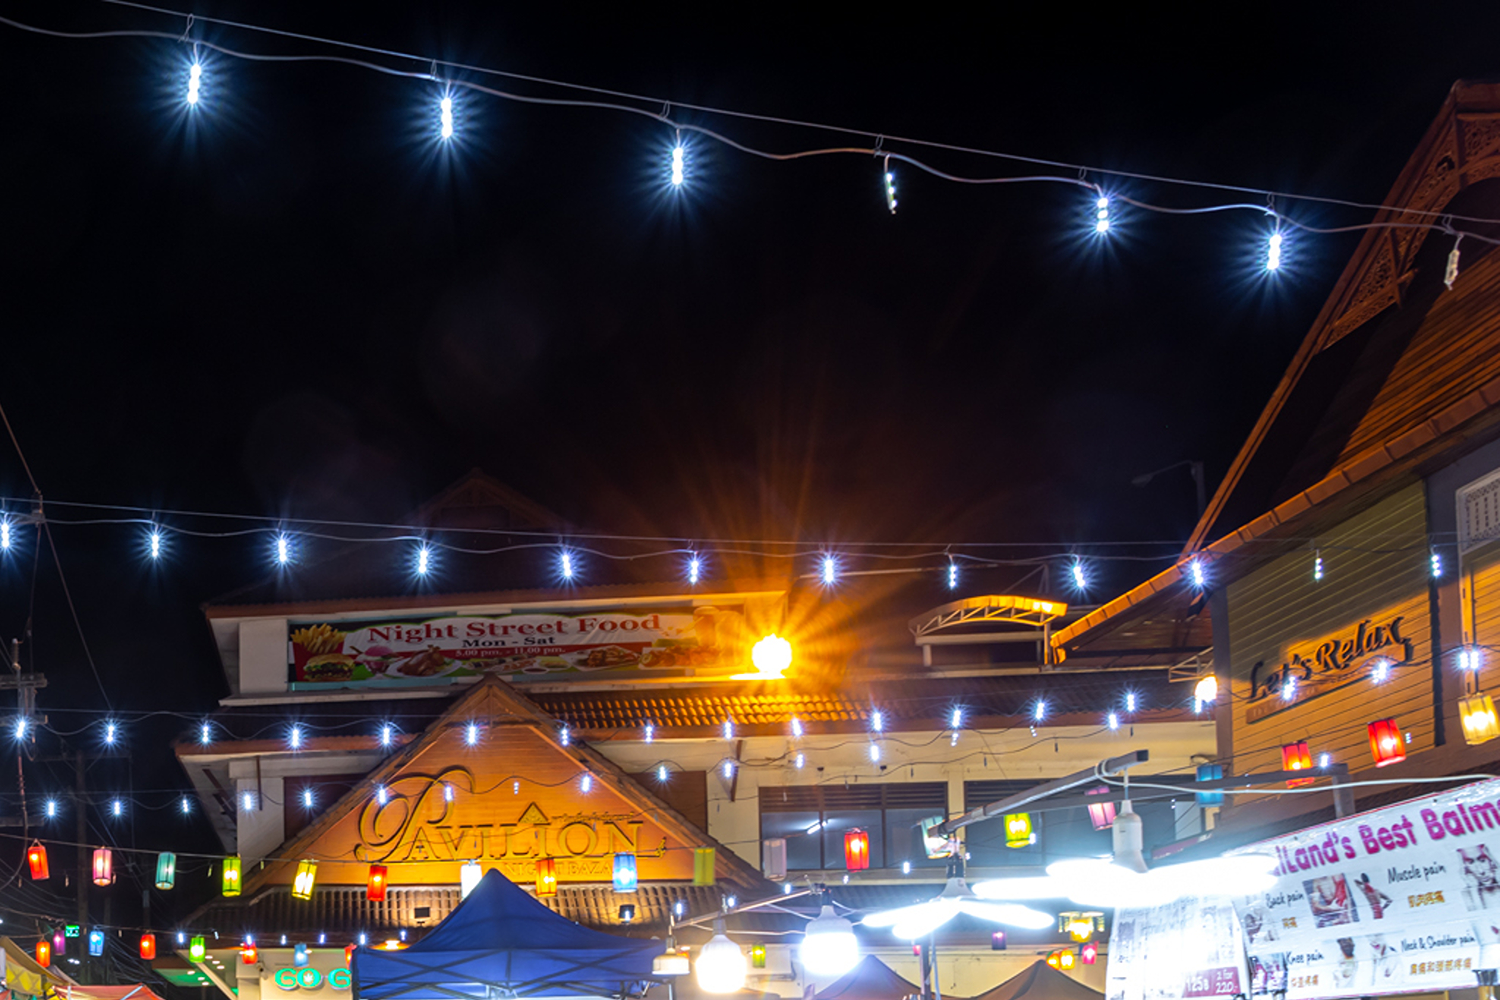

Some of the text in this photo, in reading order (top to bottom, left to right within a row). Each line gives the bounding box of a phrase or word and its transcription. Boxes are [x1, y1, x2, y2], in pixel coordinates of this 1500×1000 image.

[368, 615, 660, 646] Night Street Food
[455, 649, 478, 657] 5.00
[514, 647, 536, 655] 11.00
[462, 638, 505, 648] Mon
[523, 636, 555, 646] Sat
[1247, 653, 1312, 703] Let's
[1314, 616, 1405, 670] Relax
[1358, 814, 1418, 855] Best
[1420, 799, 1500, 840] Balm
[506, 861, 613, 877] NIGT BAZA
[1388, 862, 1446, 885] Muscle pain
[1287, 890, 1304, 907] pain
[1402, 938, 1418, 951] Neck
[1459, 930, 1476, 945] pain
[1286, 949, 1325, 965] Knee pain
[275, 967, 351, 990] GO G
